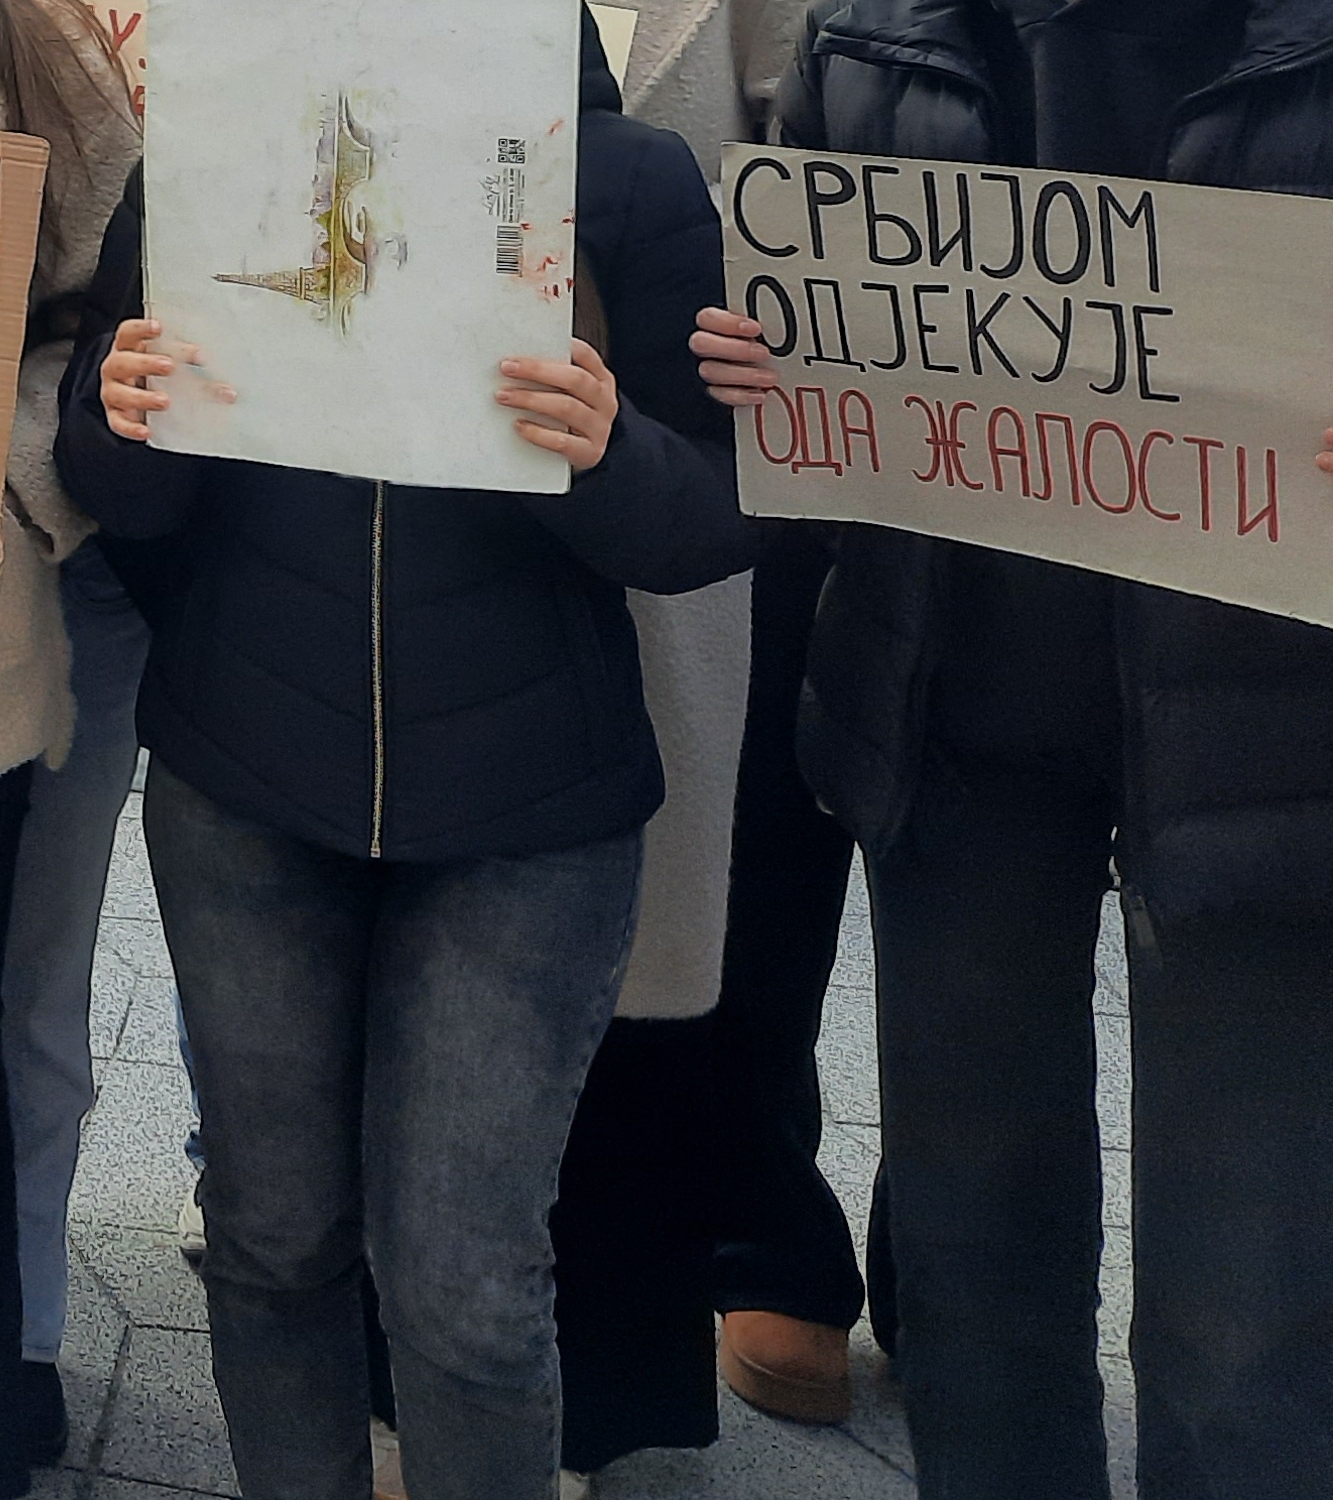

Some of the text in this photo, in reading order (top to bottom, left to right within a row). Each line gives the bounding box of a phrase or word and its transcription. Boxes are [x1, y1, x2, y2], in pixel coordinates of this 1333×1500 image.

[733, 157, 1160, 293] СРБИЈОМ
[744, 275, 1181, 402] ОДЈЕКУЈЕ
[753, 385, 1279, 543] ОДА ЖАЛОСТИ
